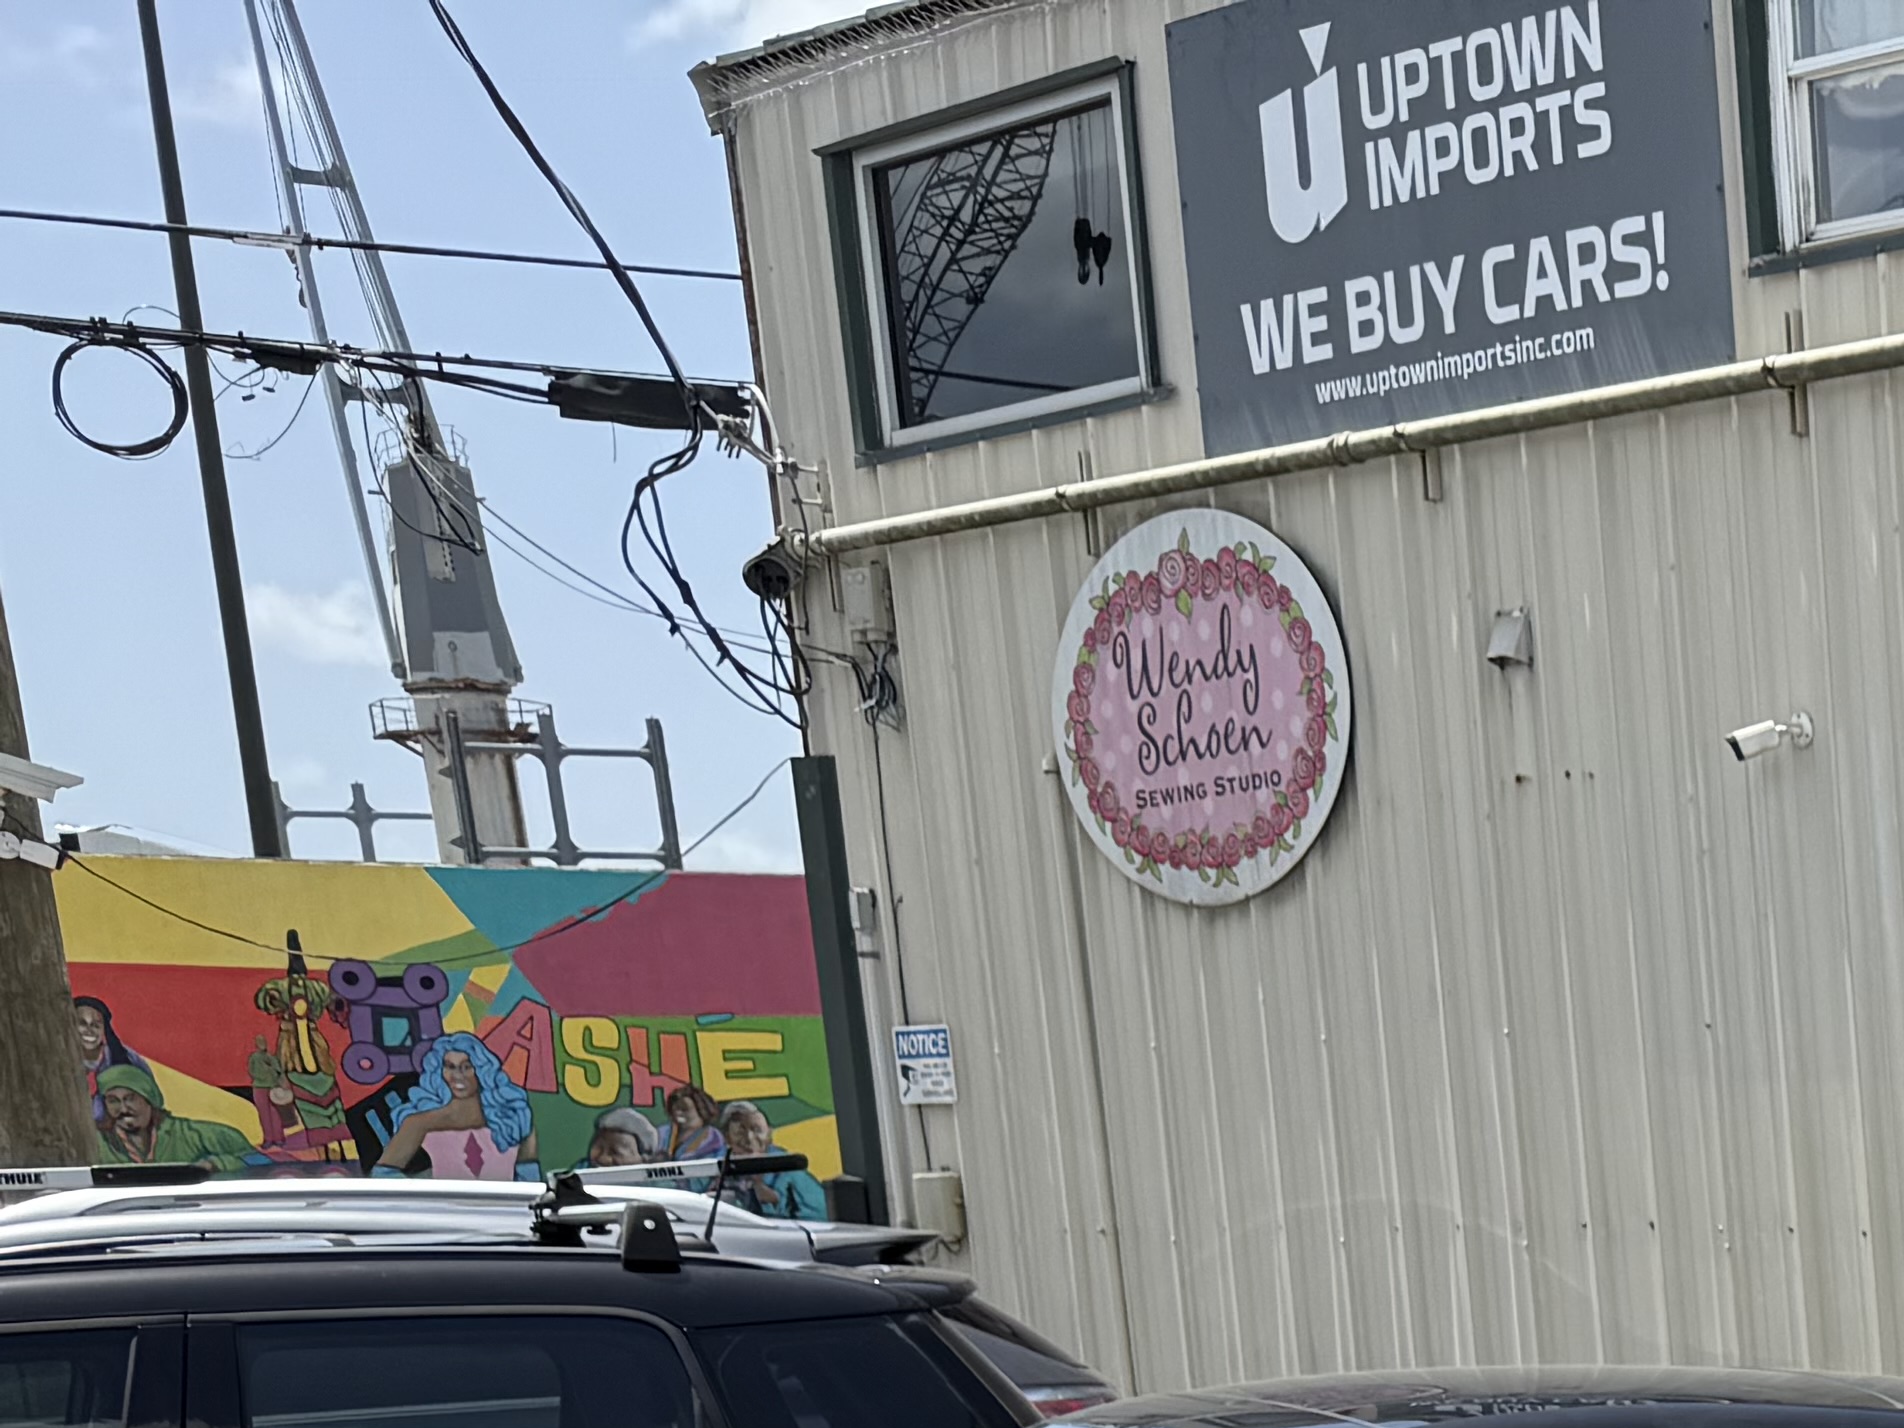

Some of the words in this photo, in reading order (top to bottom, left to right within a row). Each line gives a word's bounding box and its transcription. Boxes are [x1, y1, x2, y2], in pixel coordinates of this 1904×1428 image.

[1357, 0, 1604, 130] UPTOWN
[1364, 82, 1612, 211] IMPORTS
[1240, 285, 1334, 375] WE
[1344, 254, 1465, 354] BUY
[1481, 210, 1670, 326] CARS!
[1315, 326, 1595, 405] www.uptownimportsinc.com
[1112, 602, 1260, 715] Wendy
[1137, 689, 1273, 776] Schoen
[1135, 781, 1208, 809] SEWING
[1213, 770, 1282, 798] STUDIO
[898, 1032, 947, 1056] NOTICE
